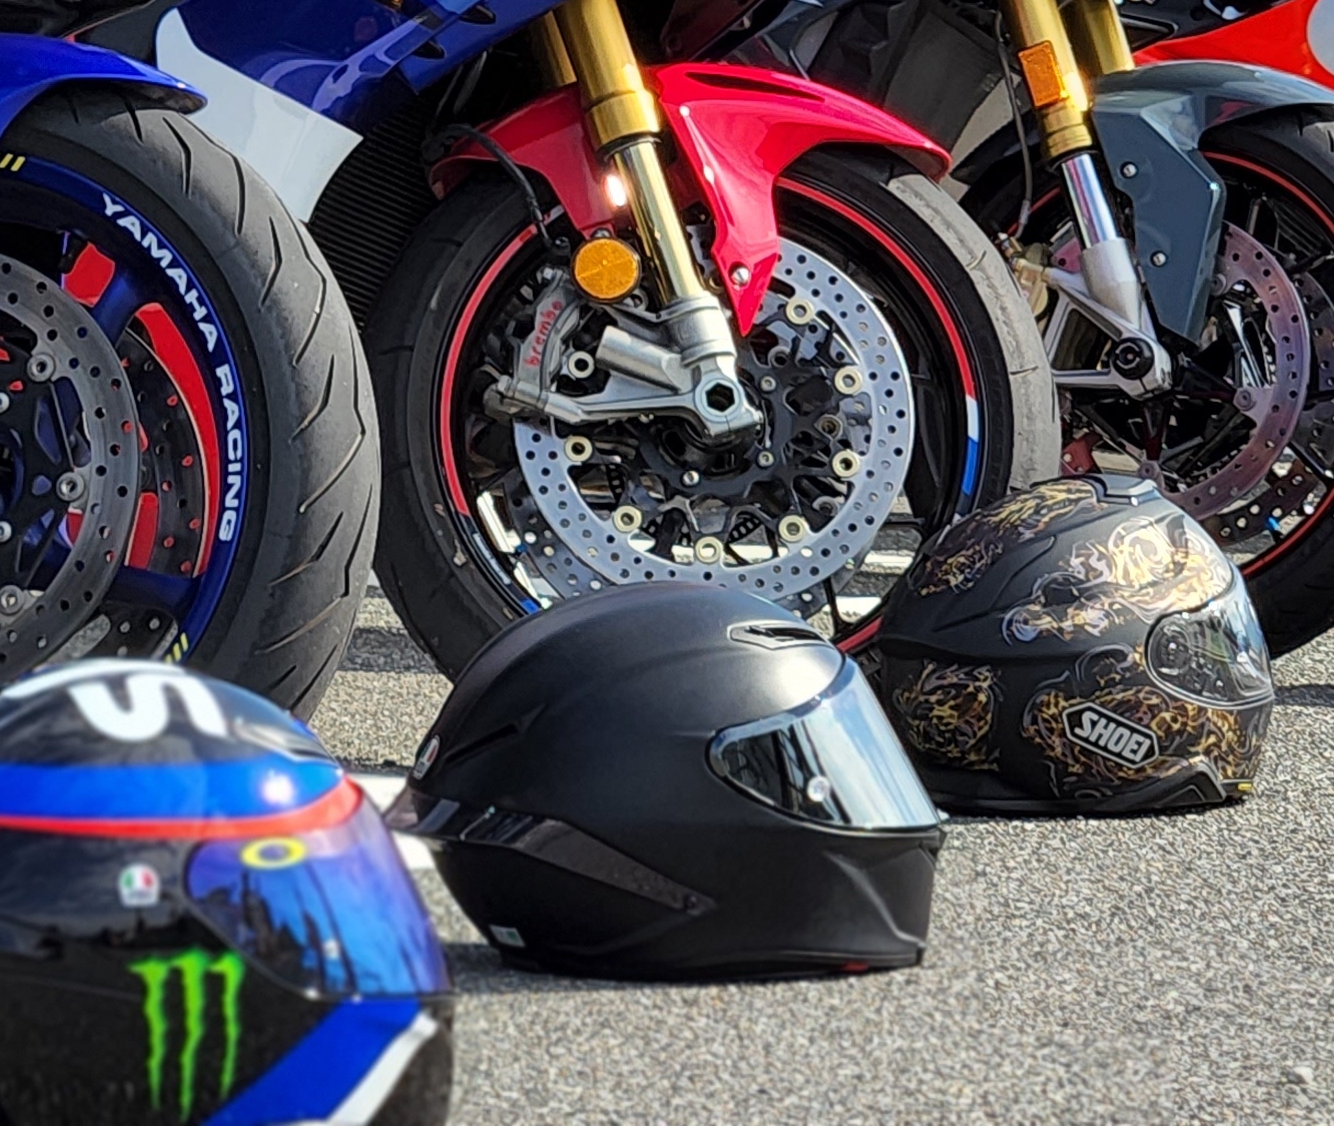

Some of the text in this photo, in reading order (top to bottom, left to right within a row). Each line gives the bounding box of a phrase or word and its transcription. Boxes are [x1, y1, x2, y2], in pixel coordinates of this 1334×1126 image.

[523, 300, 563, 367] brembo
[102, 192, 245, 544] YAMAHA RACING
[1073, 711, 1151, 762] SHOEI
